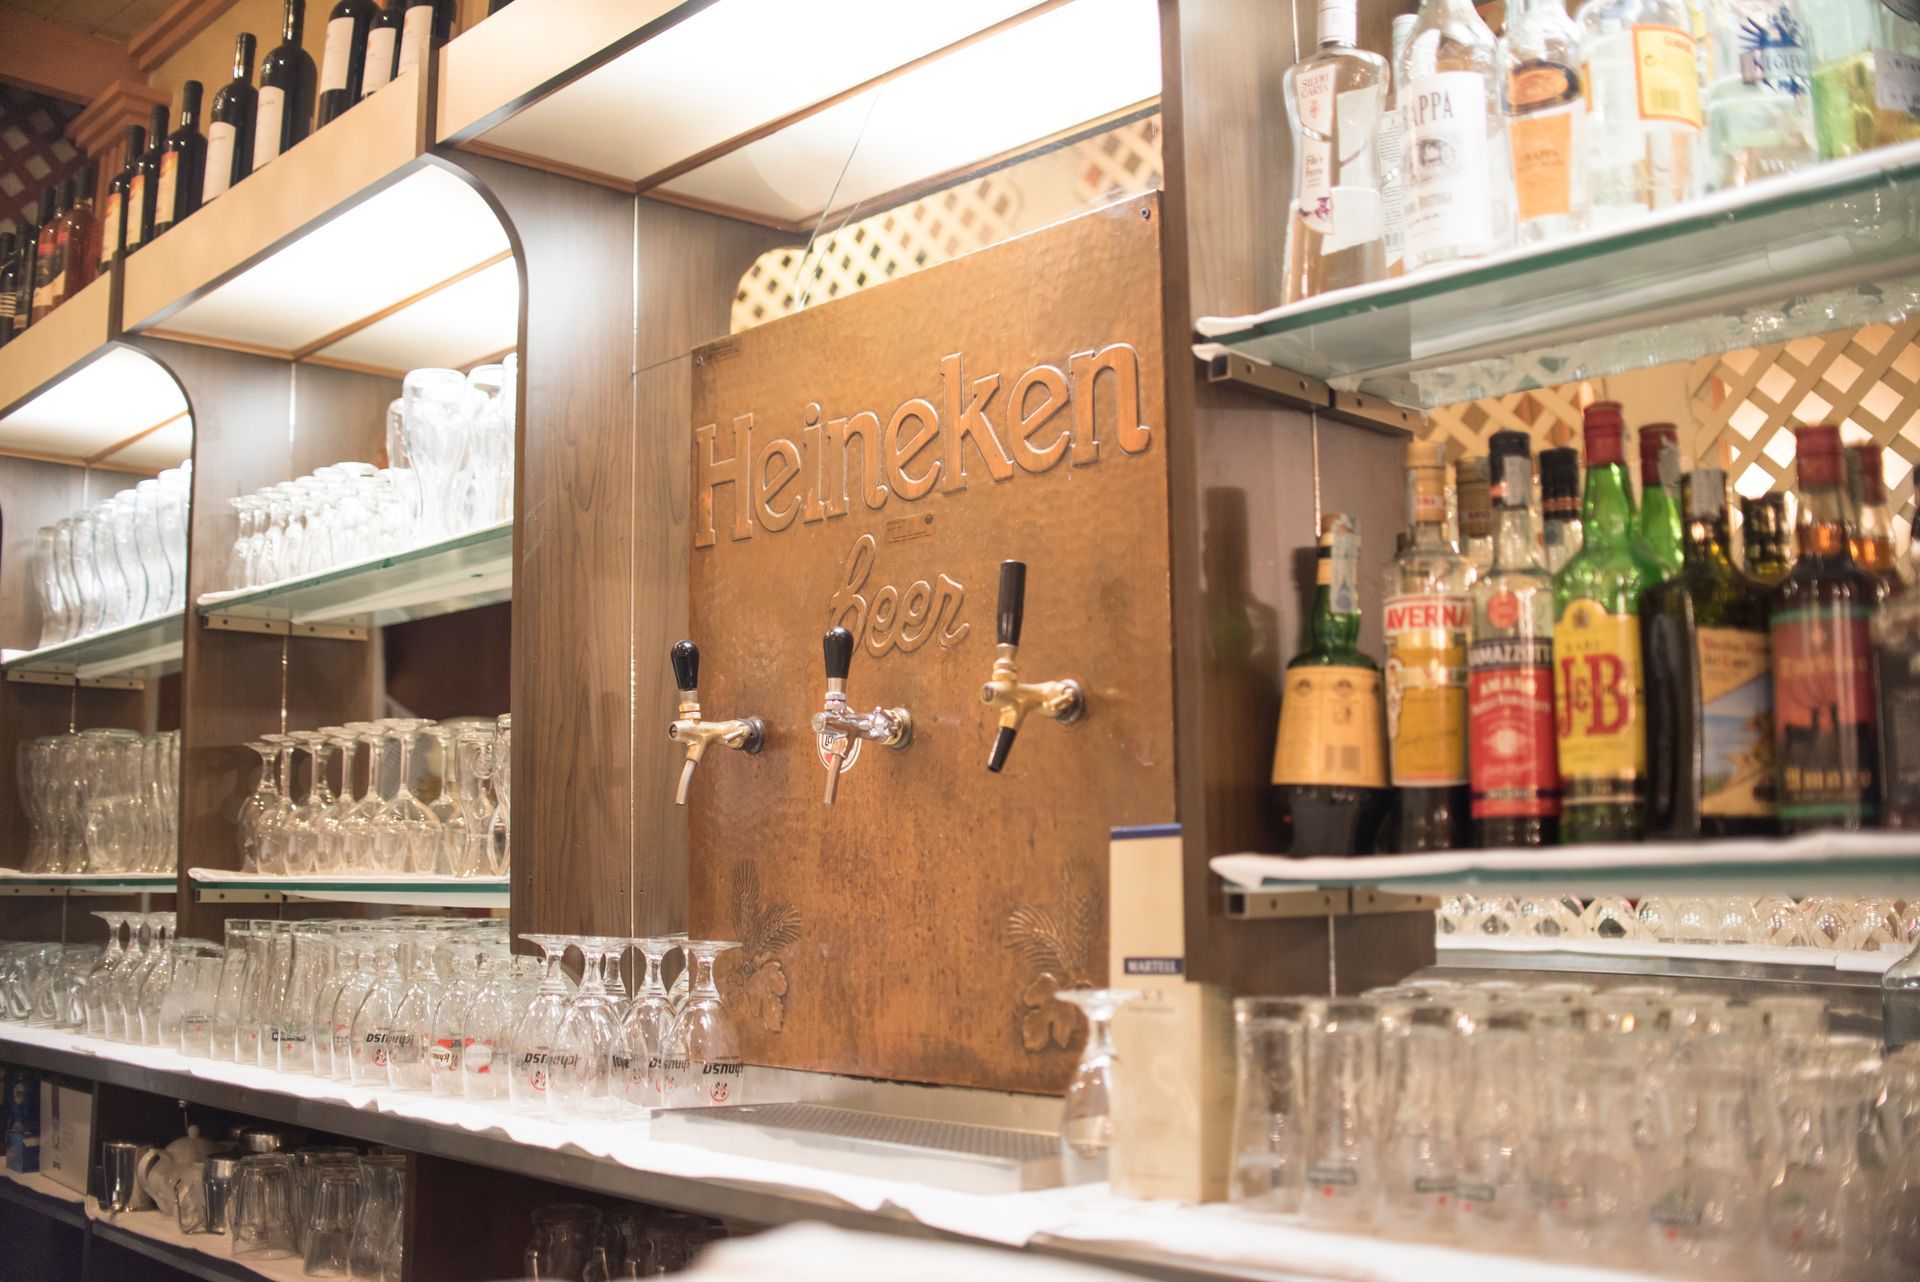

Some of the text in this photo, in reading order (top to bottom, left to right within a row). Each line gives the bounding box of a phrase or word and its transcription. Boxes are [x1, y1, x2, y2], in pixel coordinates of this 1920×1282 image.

[694, 342, 1152, 549] Heineken
[1387, 605, 1472, 631] AVERNA
[1127, 959, 1177, 974] MARTELL
